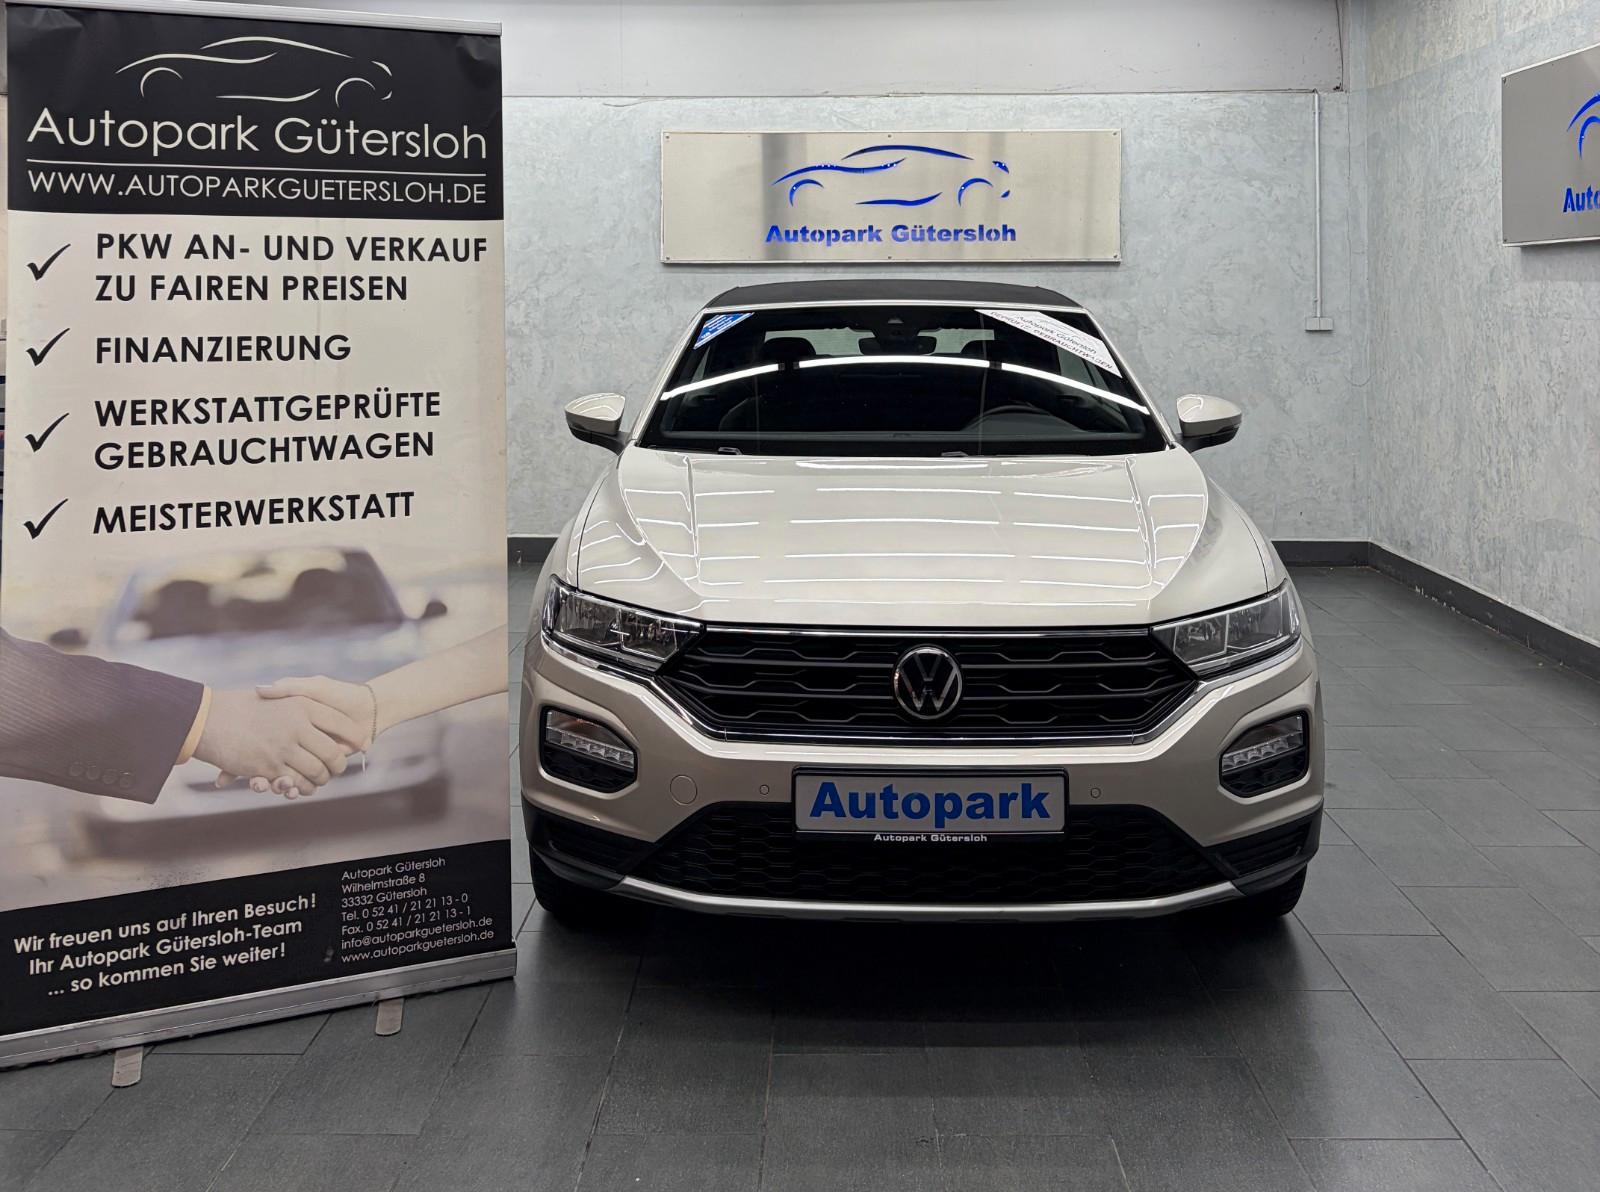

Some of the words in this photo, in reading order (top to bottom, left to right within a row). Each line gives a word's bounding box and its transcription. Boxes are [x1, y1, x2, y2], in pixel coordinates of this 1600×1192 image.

[27, 107, 259, 156] Autopark
[275, 118, 487, 159] Gütersloh
[28, 170, 486, 204] WWW.AUTOPARKGUETERSLOH.DE
[96, 233, 171, 260] PKW
[184, 234, 249, 260] AN-
[264, 235, 334, 261] UND
[346, 237, 487, 262] VERKAUF
[765, 225, 882, 246] Autopark
[891, 223, 1016, 243] Gütersloh
[95, 276, 135, 301] ZU
[151, 275, 269, 301] FAIREN
[282, 276, 407, 301] PREISEN
[96, 334, 351, 364] FINANZIERUNG
[95, 387, 440, 427] WERKSTATTGEPRÜFTE
[95, 431, 434, 470] GEBRAUCHTWAGEN
[93, 492, 415, 534] MEISTERWERKSTATT
[809, 781, 1051, 828] Autopark
[874, 834, 927, 843] Autopark
[931, 833, 988, 842] Gütersloh
[341, 865, 392, 881] Autopark
[395, 857, 446, 873] Gütersloh
[342, 875, 416, 894] Wilhelmstraße
[418, 872, 425, 883] 8
[341, 894, 374, 908] 33332
[376, 887, 427, 903] Gütersloh
[341, 910, 359, 922] Tel.
[362, 908, 370, 919] 0
[372, 906, 385, 918] 52
[387, 904, 398, 915] 41
[410, 899, 421, 911] 21
[425, 897, 436, 909] 21
[441, 895, 453, 906] 13
[461, 892, 469, 903] 0
[14, 934, 43, 954] Wir
[49, 927, 112, 948] freuen
[118, 922, 151, 938] uns
[156, 913, 187, 933] auf
[192, 905, 238, 926] Ihren
[244, 893, 316, 920] Besuch!
[341, 924, 364, 936] Fax.
[366, 921, 374, 933] 0
[376, 918, 389, 930] 52
[391, 916, 403, 927] 41
[414, 912, 426, 924] 21
[429, 910, 441, 922] 21
[445, 907, 457, 919] 13
[466, 905, 471, 916] 1
[341, 916, 493, 950] info@autoparkguetersloh.de
[29, 957, 53, 976] Ihr
[60, 942, 150, 972] Autopark
[156, 918, 302, 955] Gütersloh-Team
[341, 930, 494, 963] www.autoparkguetersloh.de
[70, 977, 93, 993] so
[98, 963, 184, 987] kommen
[190, 955, 216, 973] Sie
[222, 943, 286, 967] weiter!
